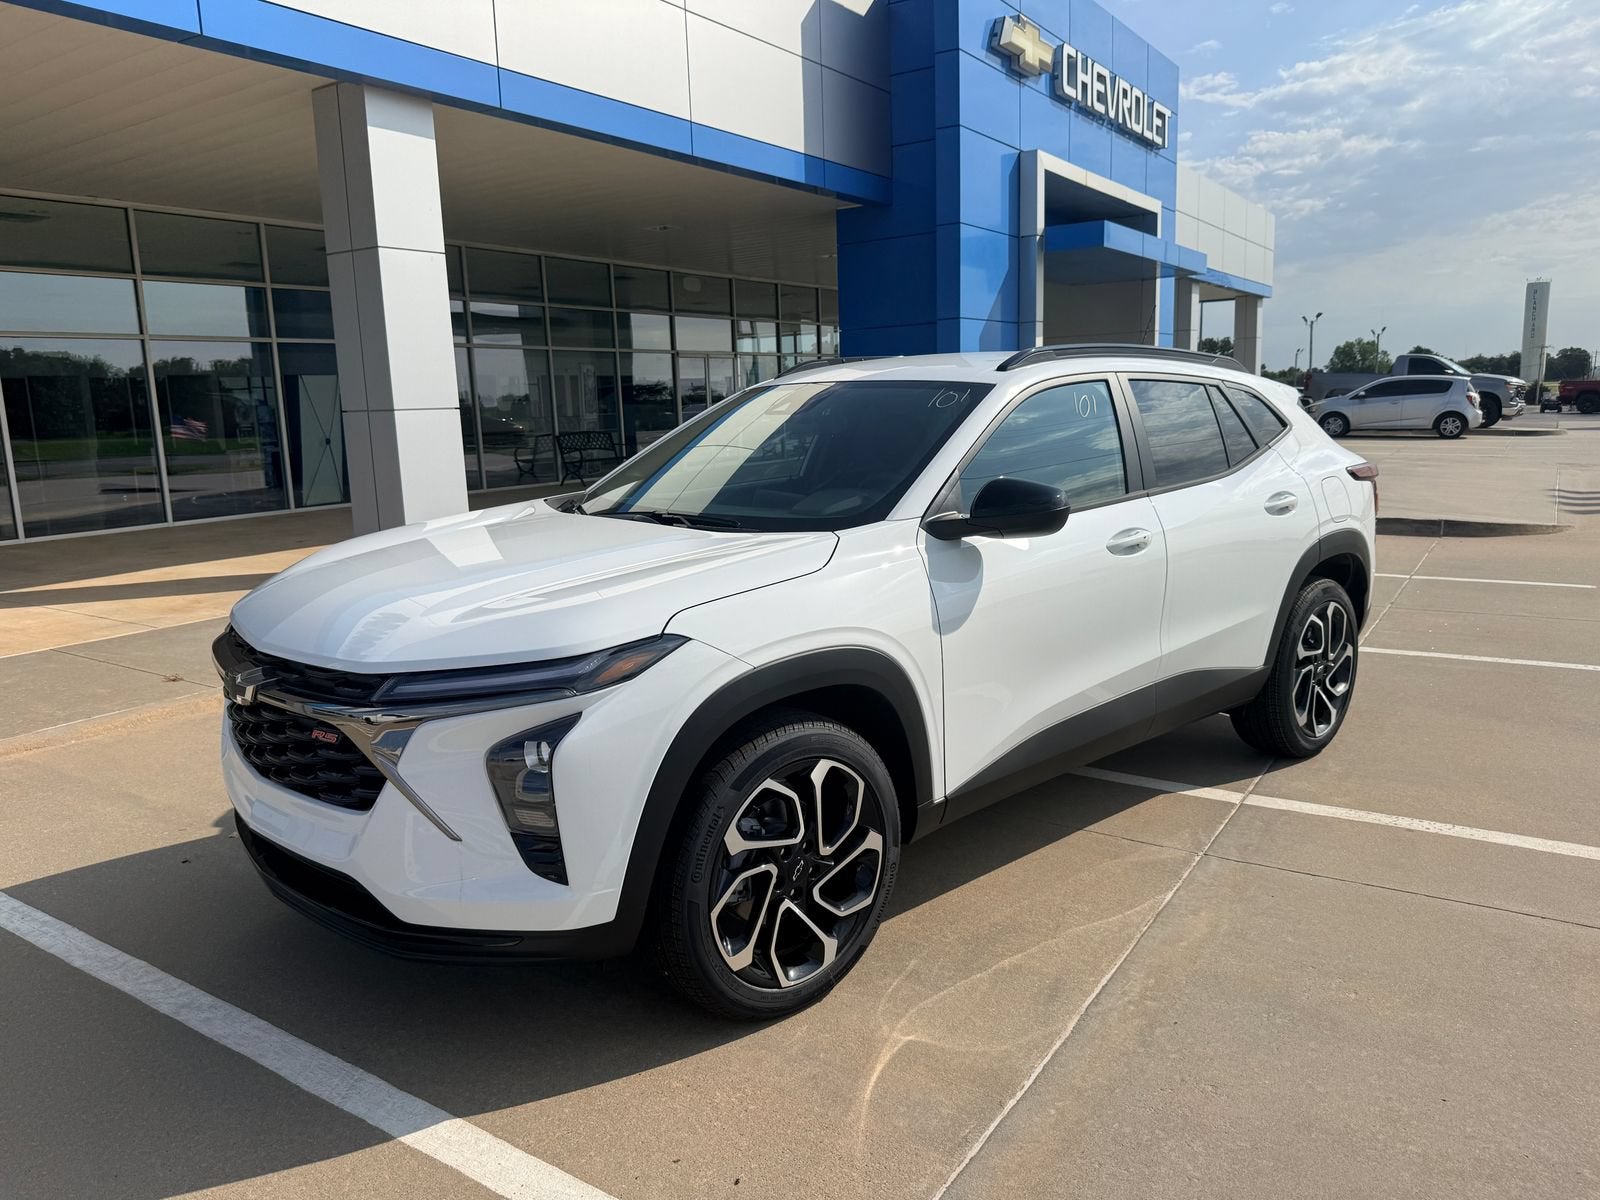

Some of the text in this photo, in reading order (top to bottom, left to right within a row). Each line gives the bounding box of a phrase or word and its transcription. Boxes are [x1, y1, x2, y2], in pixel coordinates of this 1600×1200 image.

[1059, 43, 1172, 149] CHEVROLET
[928, 387, 971, 408] 101
[1072, 391, 1097, 418] 101
[312, 729, 338, 744] RS
[691, 812, 722, 884] Continental
